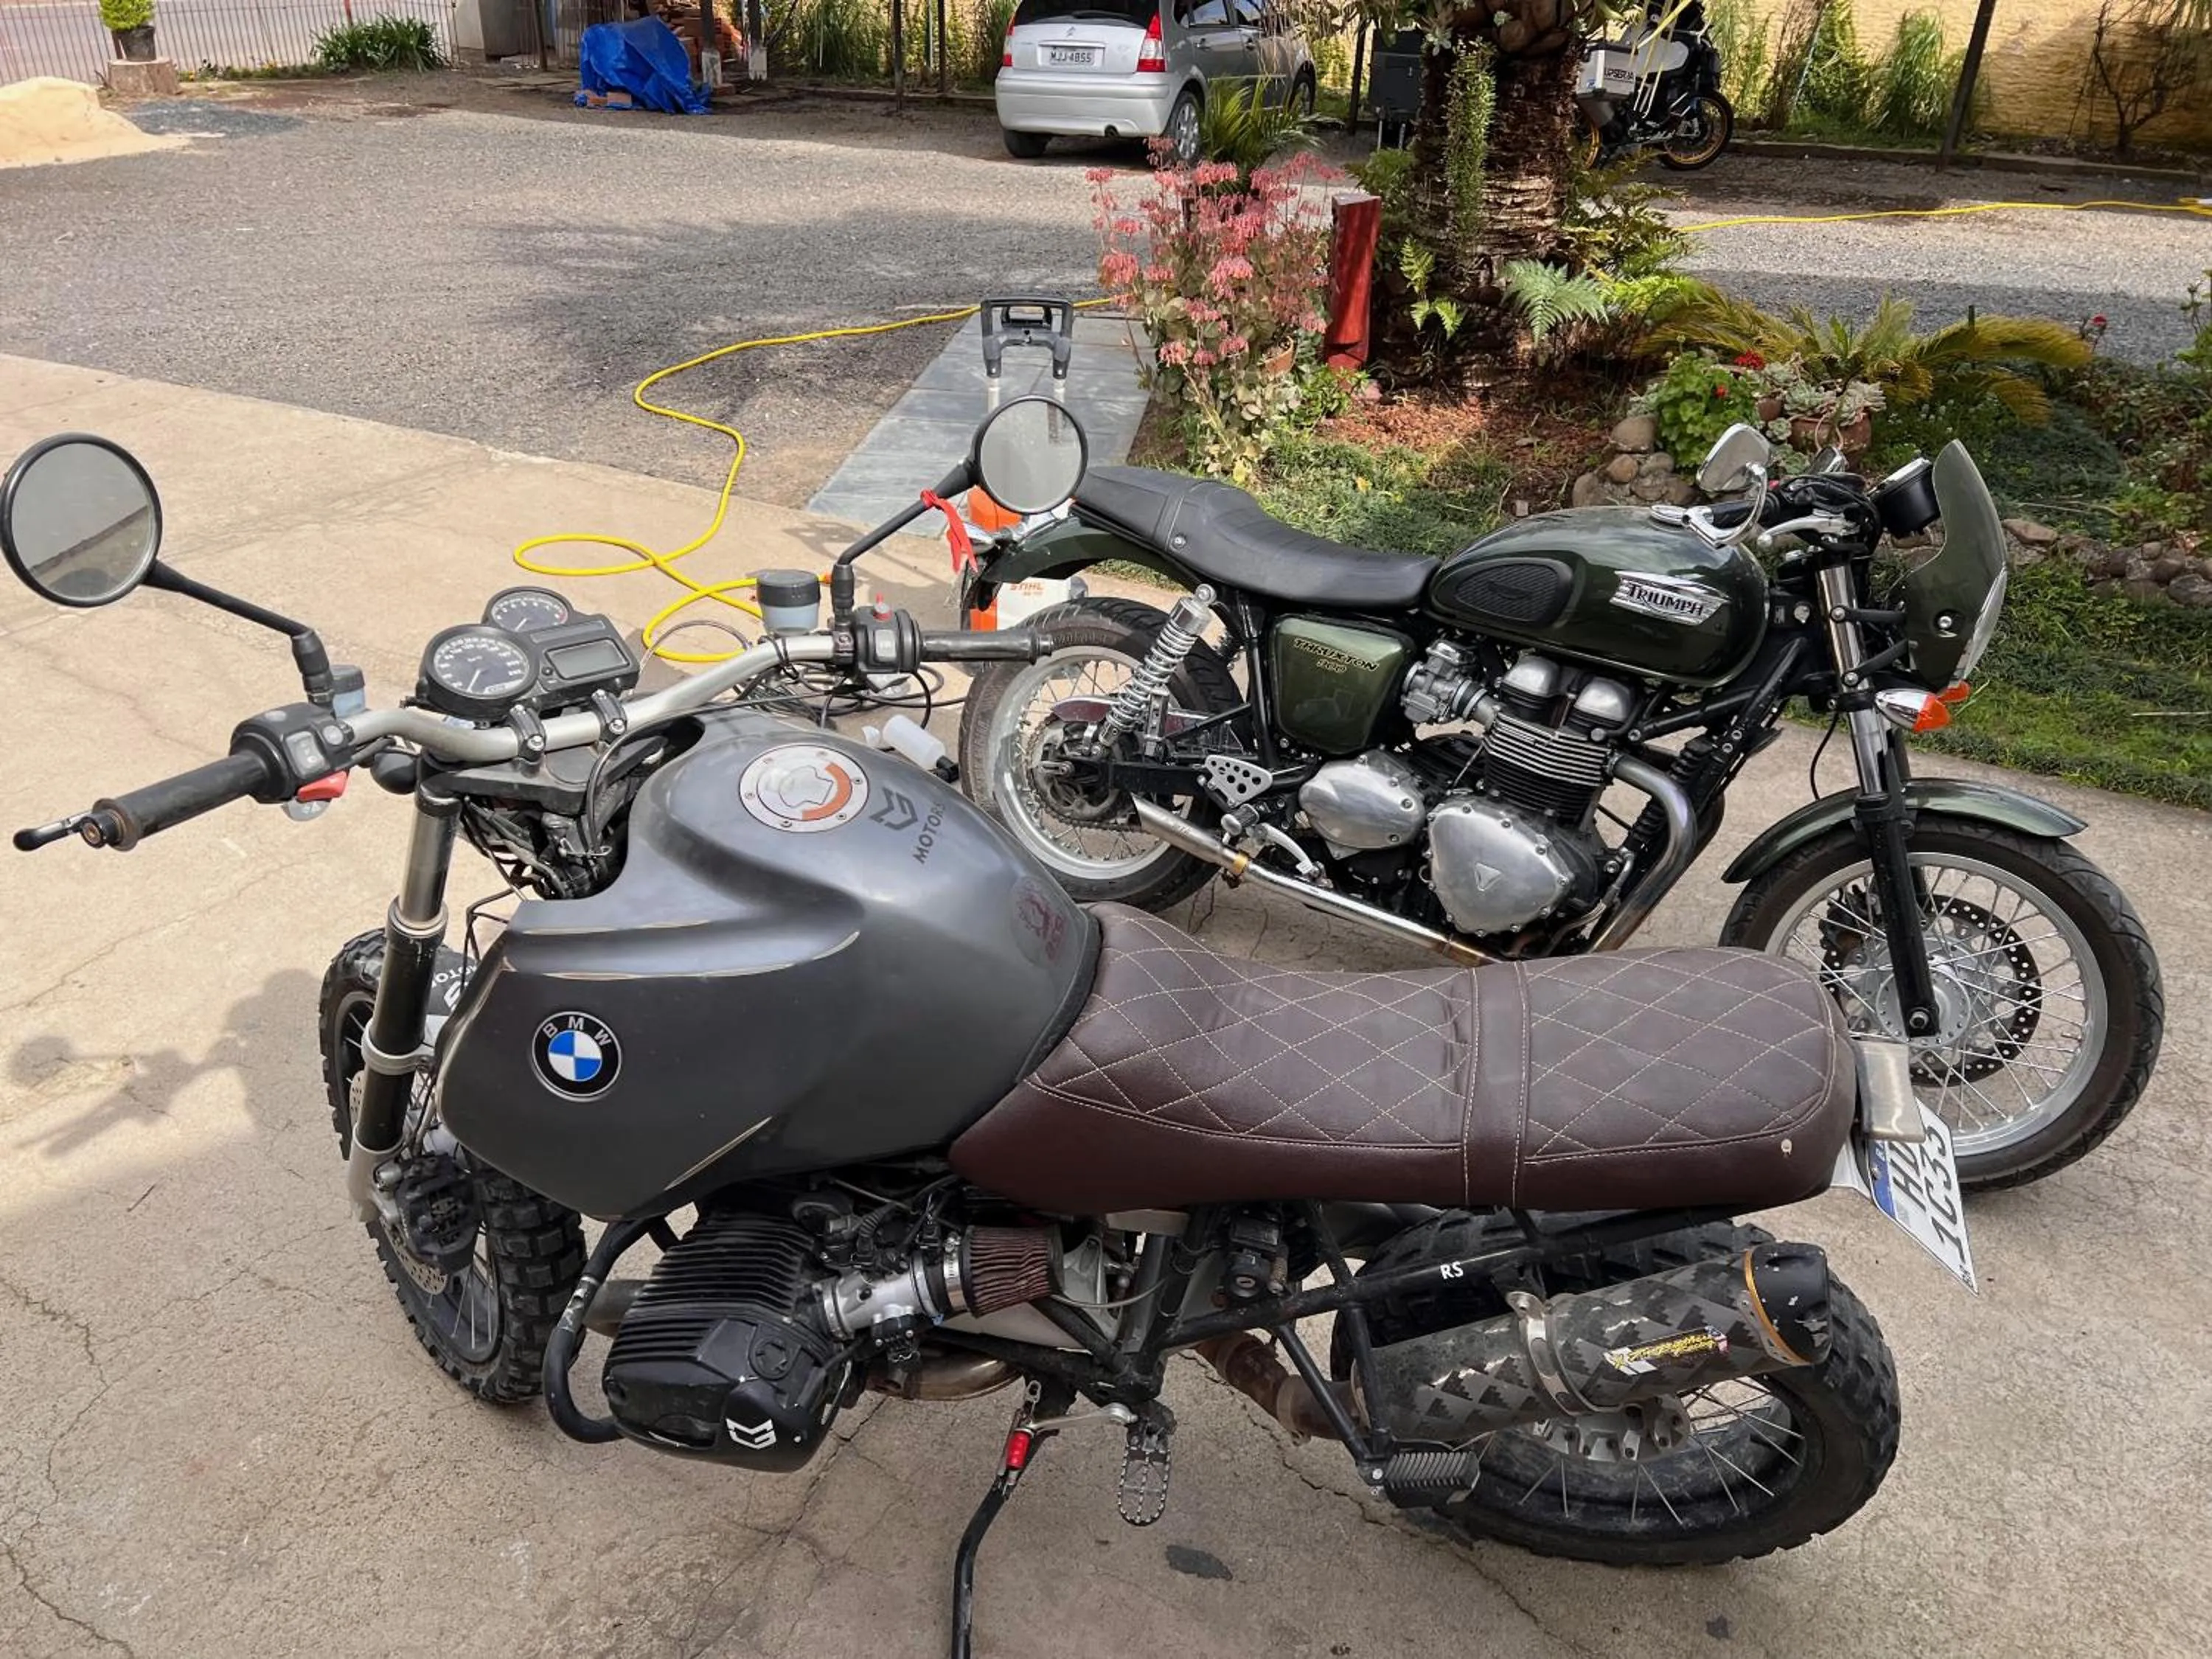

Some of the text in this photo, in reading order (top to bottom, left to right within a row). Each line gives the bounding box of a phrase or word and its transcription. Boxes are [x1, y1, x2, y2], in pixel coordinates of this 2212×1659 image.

[1627, 583, 1705, 616] TRIUMPH
[1294, 638, 1380, 672] THRUXTON
[913, 801, 945, 864] MOTORS
[542, 1015, 612, 1046] BMW
[1889, 1142, 1927, 1213] HD
[1919, 1127, 1966, 1265] 1C33
[1440, 1261, 1464, 1279] RS
